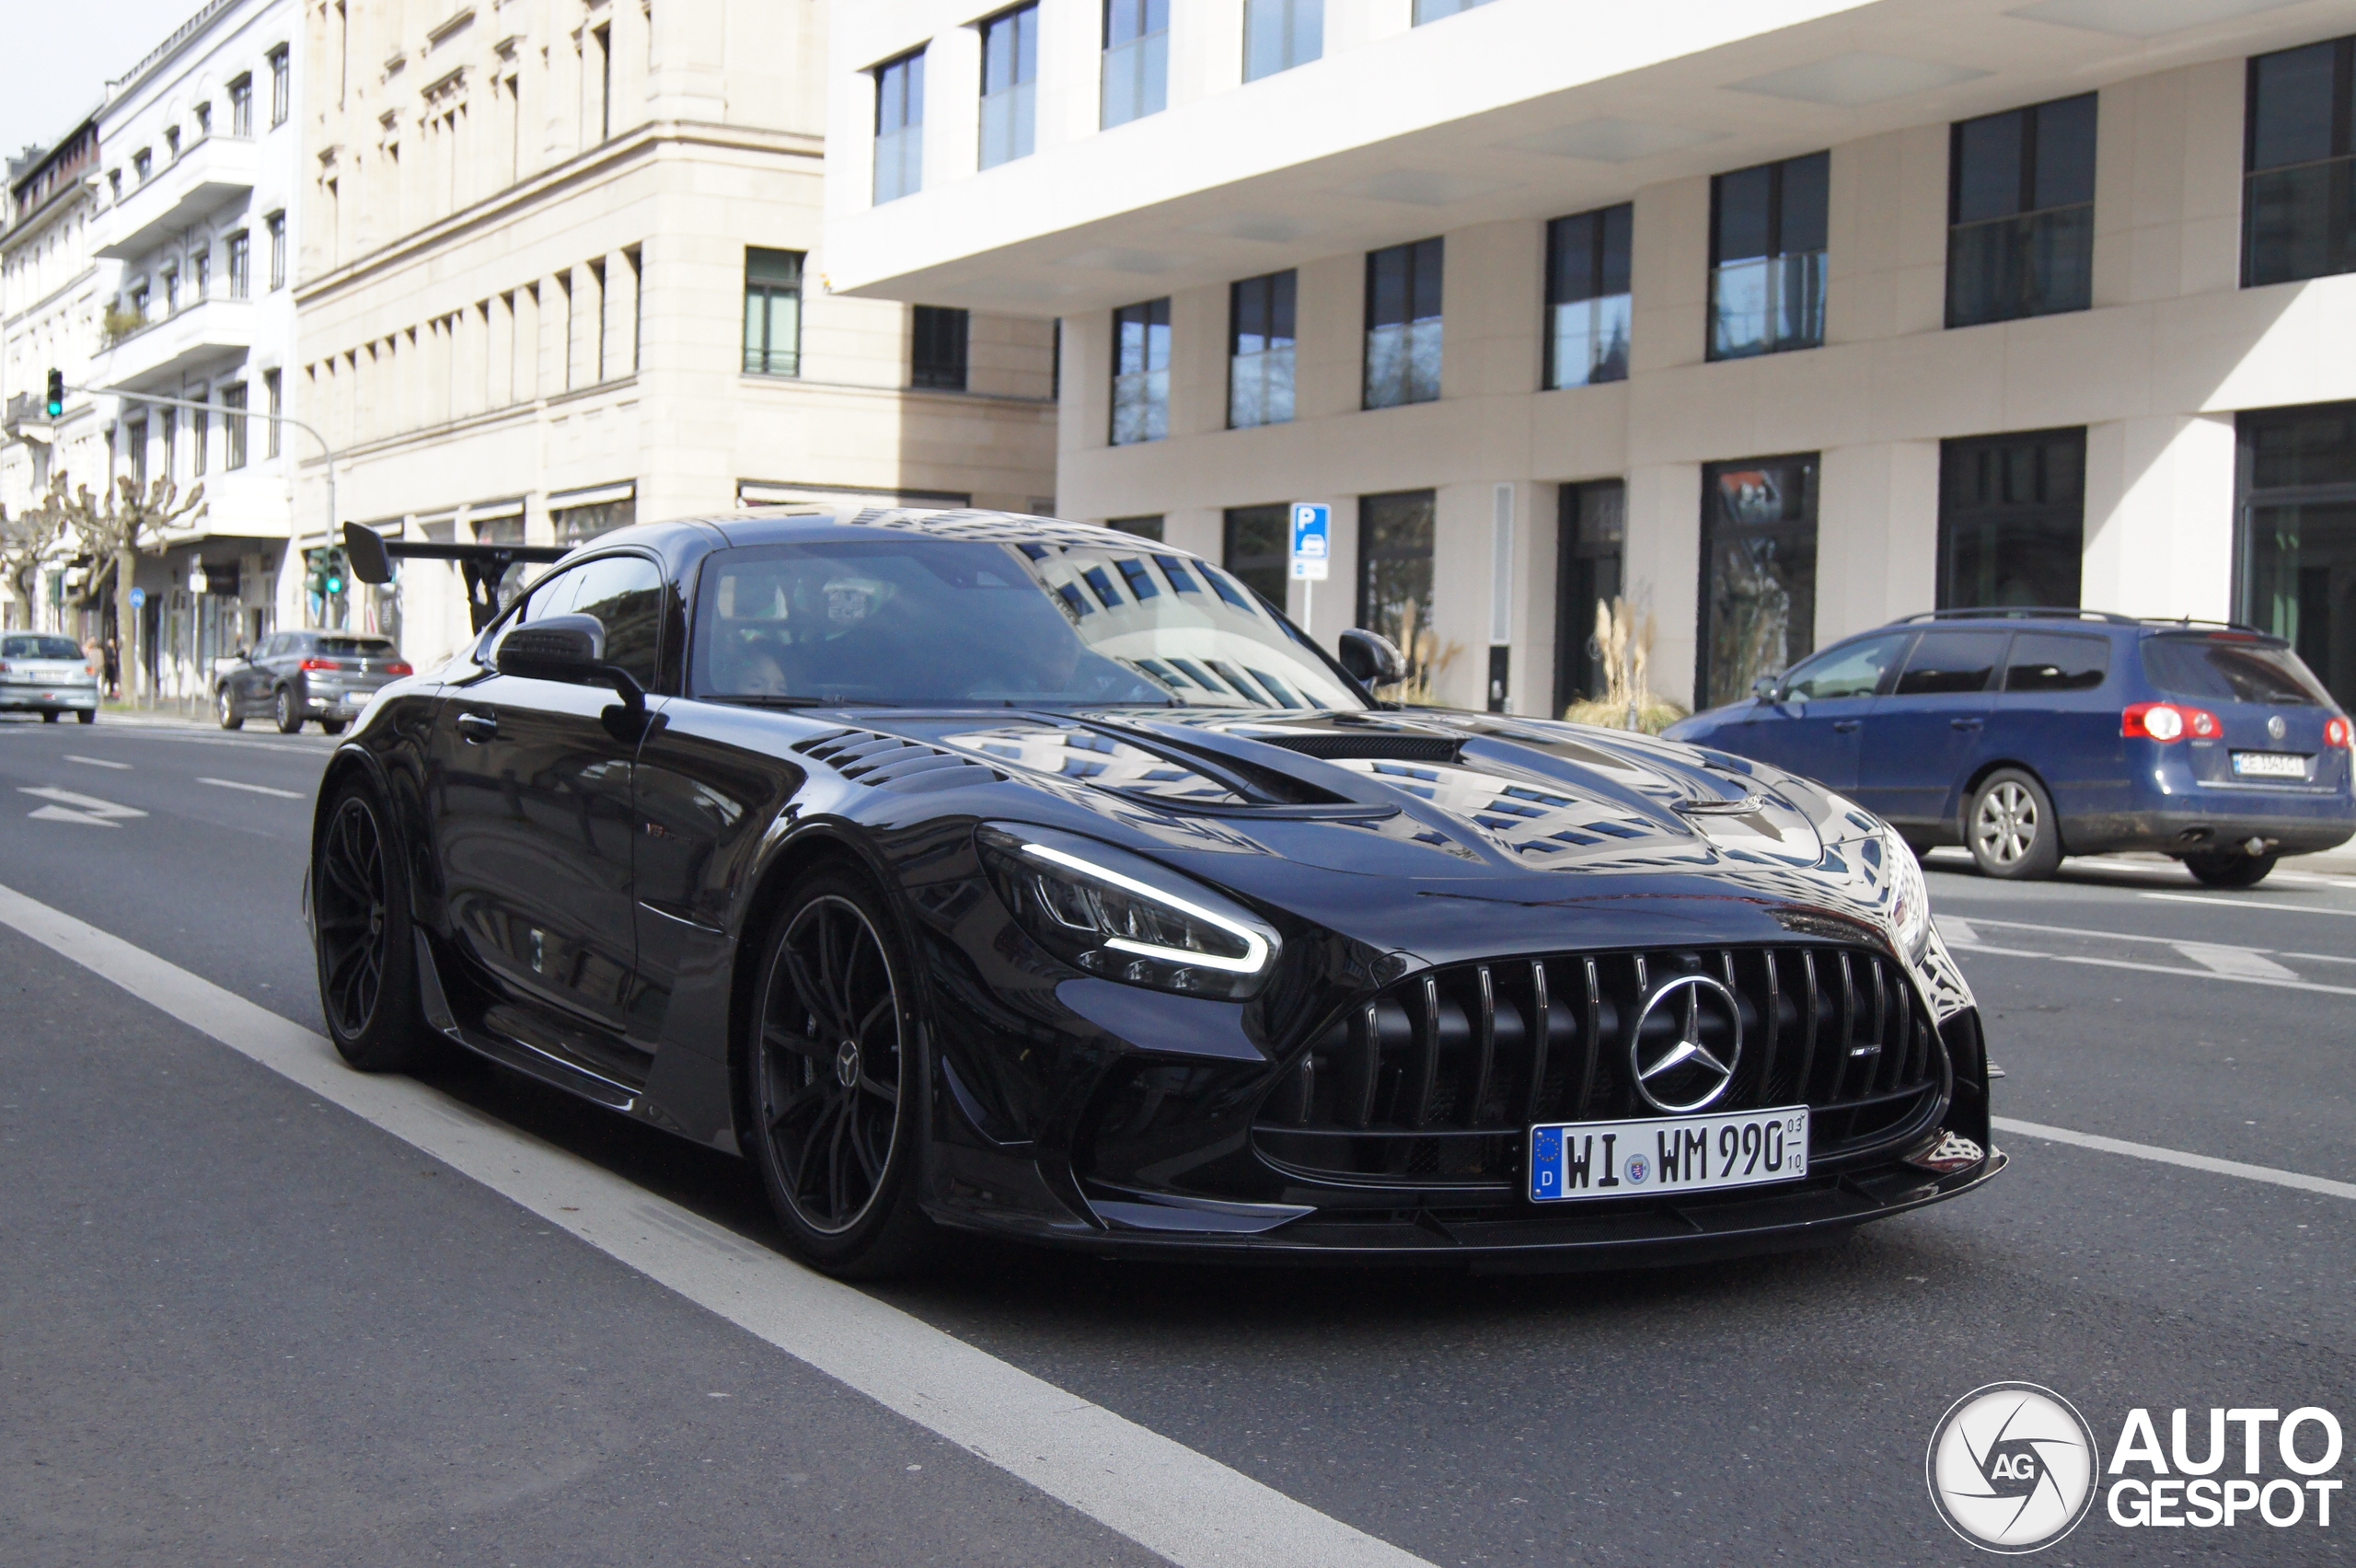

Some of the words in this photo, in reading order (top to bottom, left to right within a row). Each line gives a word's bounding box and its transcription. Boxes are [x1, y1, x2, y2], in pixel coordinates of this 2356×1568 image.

[1298, 507, 1316, 532] P
[1787, 1118, 1802, 1132] 03
[1566, 1134, 1619, 1189] WI
[1657, 1127, 1707, 1183] WM
[1719, 1119, 1783, 1177] 990
[1787, 1154, 1802, 1169] 10
[1542, 1170, 1553, 1186] D
